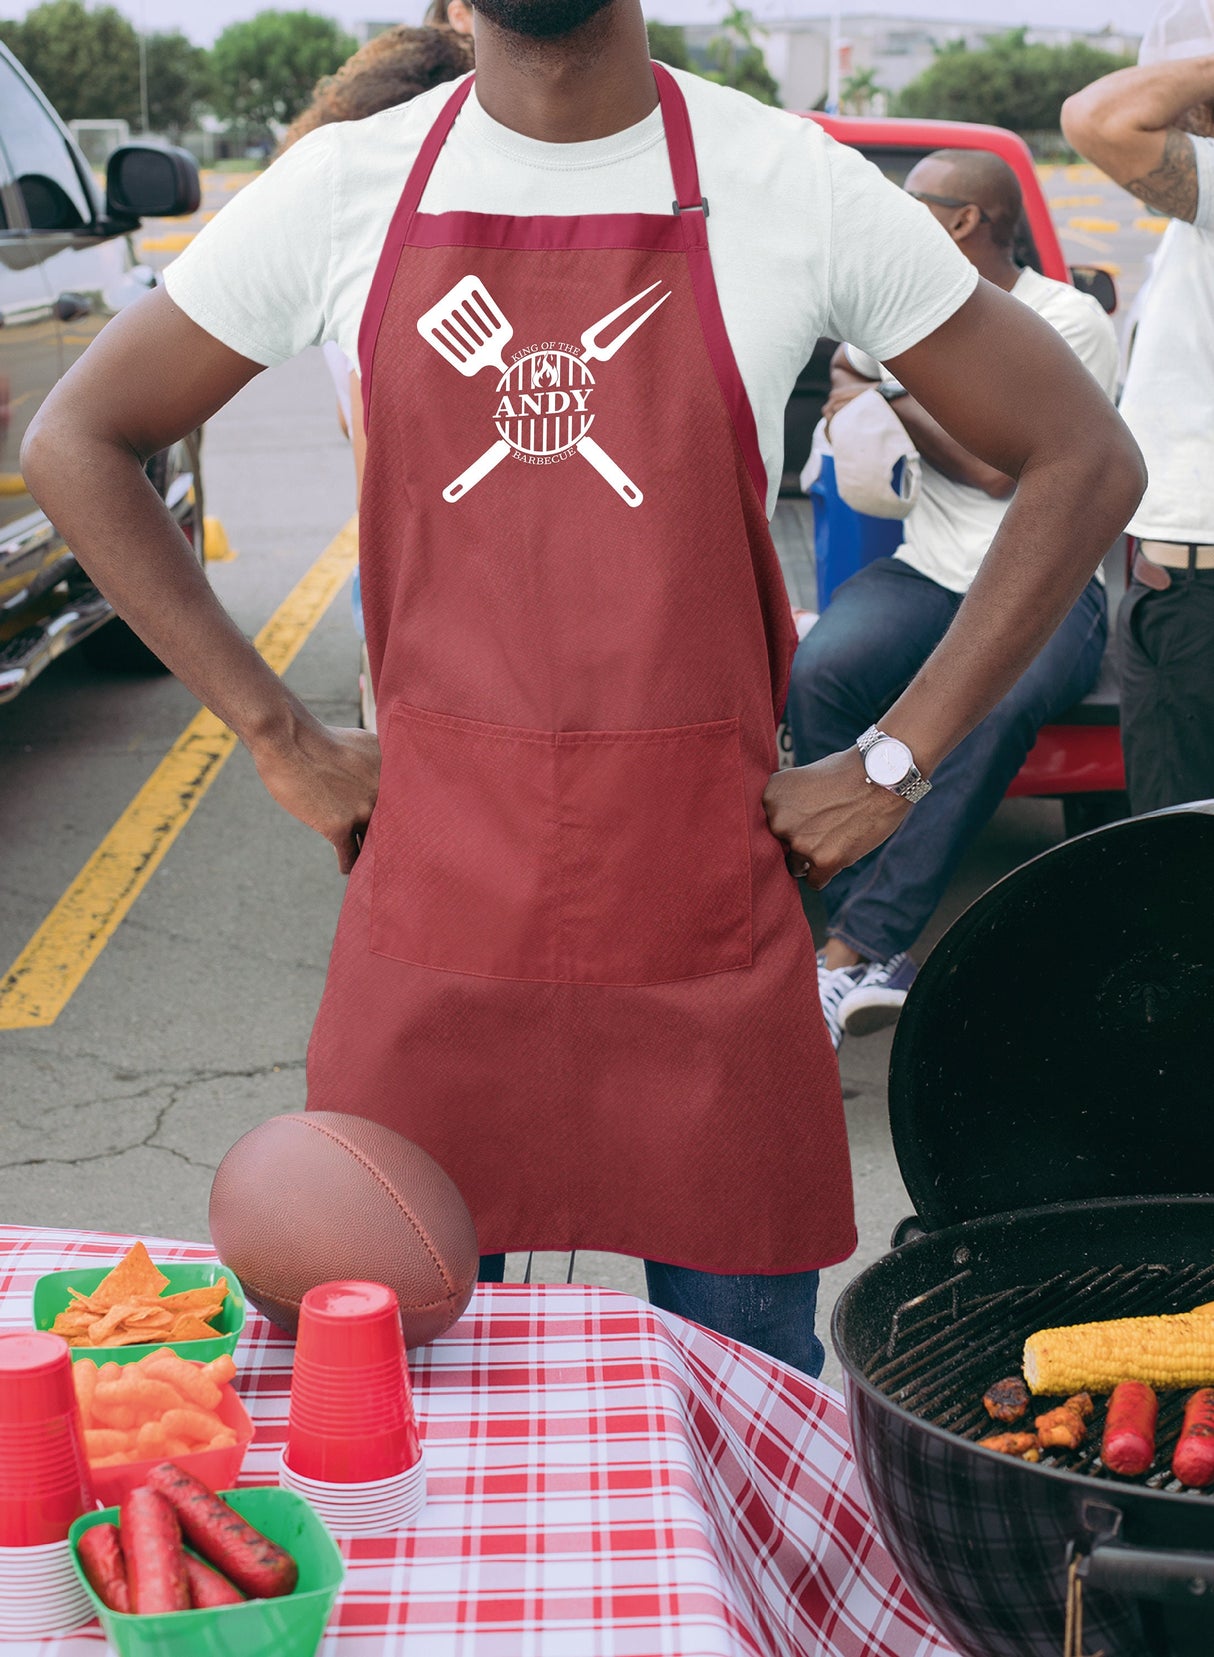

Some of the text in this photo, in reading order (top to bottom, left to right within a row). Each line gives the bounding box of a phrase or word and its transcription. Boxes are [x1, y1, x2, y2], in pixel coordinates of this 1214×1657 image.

[511, 341, 580, 362] KING OF THE
[492, 388, 594, 418] ANDY
[512, 447, 577, 465] BARBECUE
